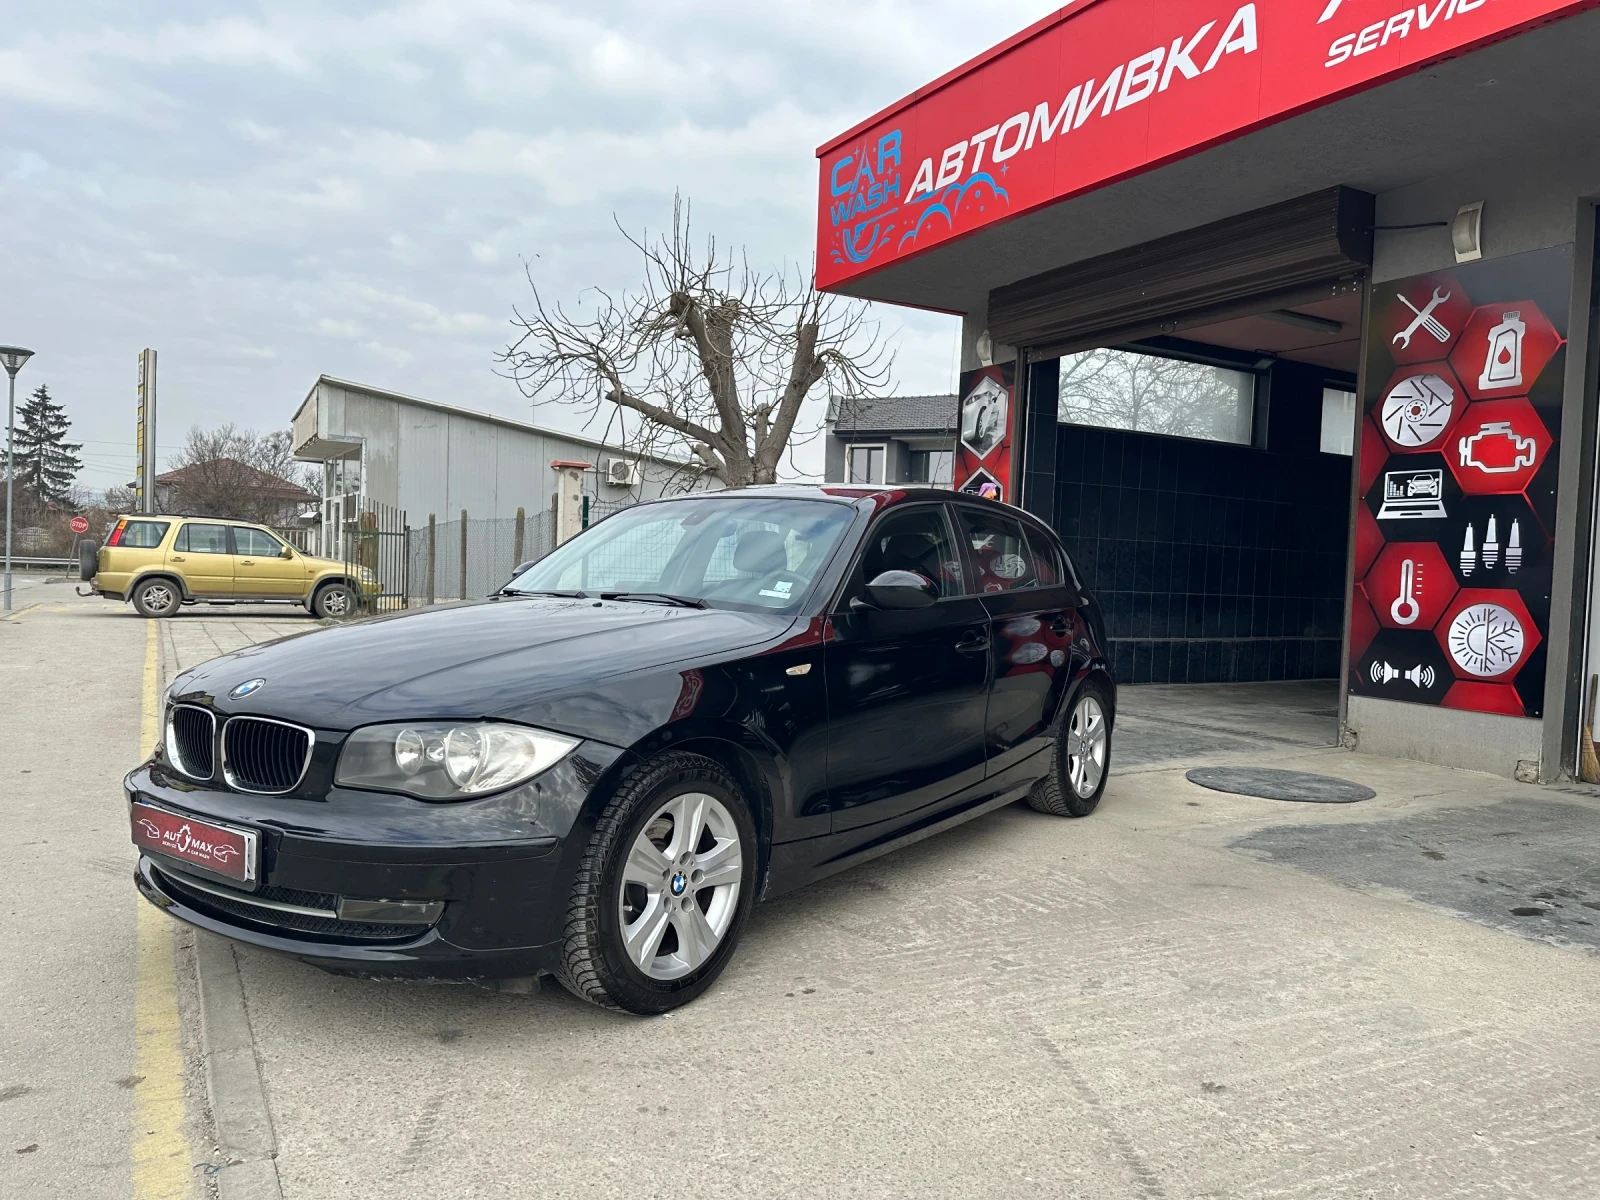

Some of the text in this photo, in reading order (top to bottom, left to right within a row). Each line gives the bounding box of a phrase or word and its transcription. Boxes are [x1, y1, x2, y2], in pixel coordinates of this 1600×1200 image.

[903, 2, 1258, 204] АВТОМИВКА
[831, 129, 903, 197] CAR
[830, 173, 901, 227] WASH
[71, 520, 87, 529] STOP
[191, 838, 213, 853] MAX
